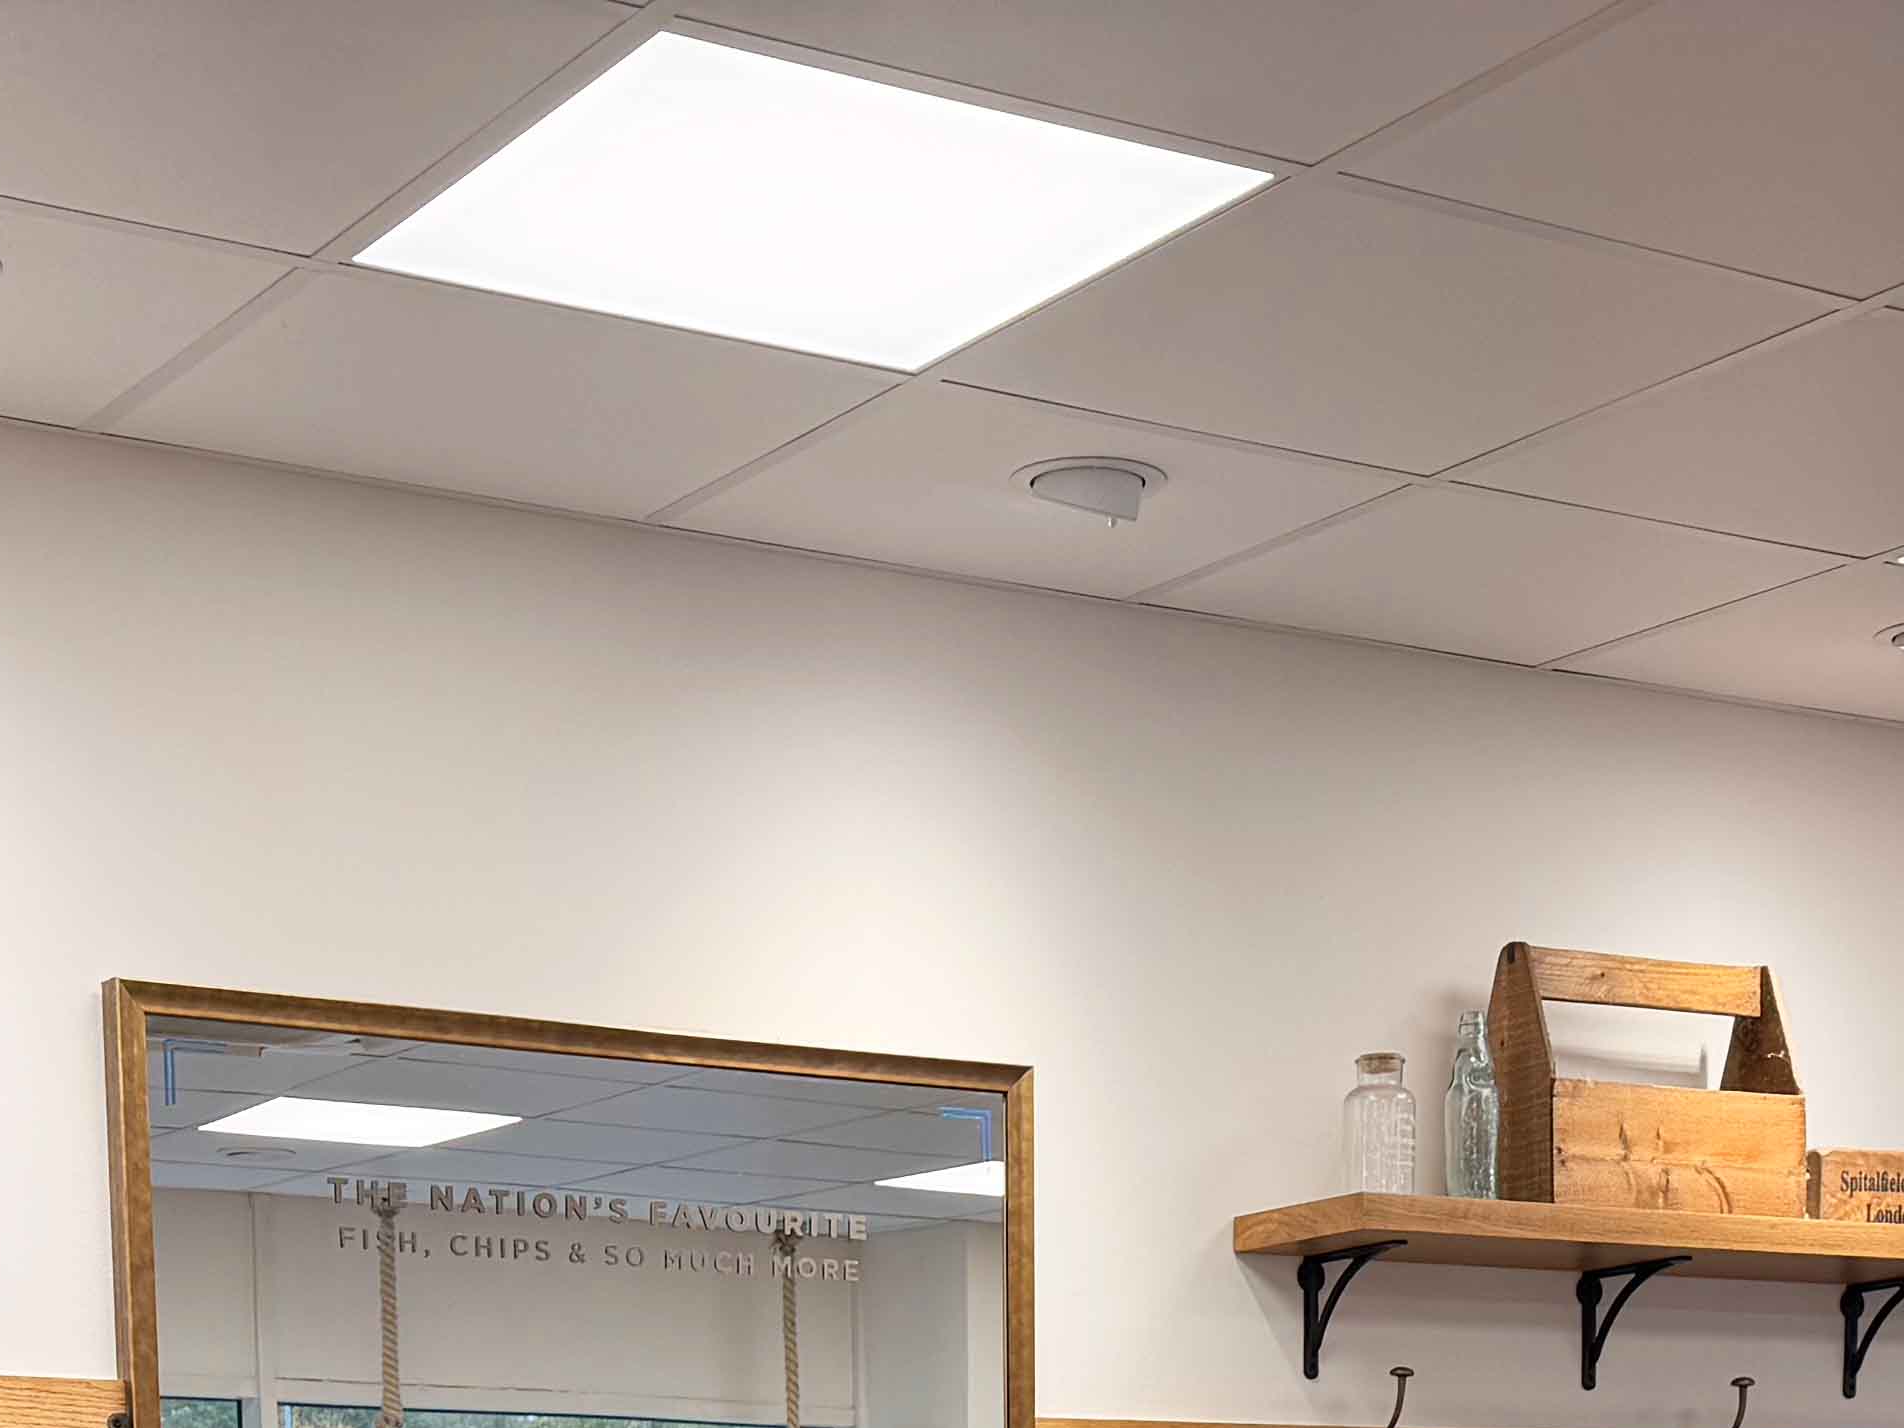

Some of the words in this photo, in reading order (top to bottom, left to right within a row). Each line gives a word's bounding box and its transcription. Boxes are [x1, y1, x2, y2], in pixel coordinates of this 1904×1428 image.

[326, 1176, 408, 1210] THE
[429, 1184, 629, 1224] NATION'S
[648, 1200, 869, 1241] FAVOURITE
[337, 1226, 432, 1259] FISH,
[449, 1234, 552, 1262] CHIPS
[567, 1242, 587, 1264] &
[603, 1245, 646, 1268] SO
[663, 1248, 756, 1276] MUCH
[772, 1254, 860, 1281] MORE
